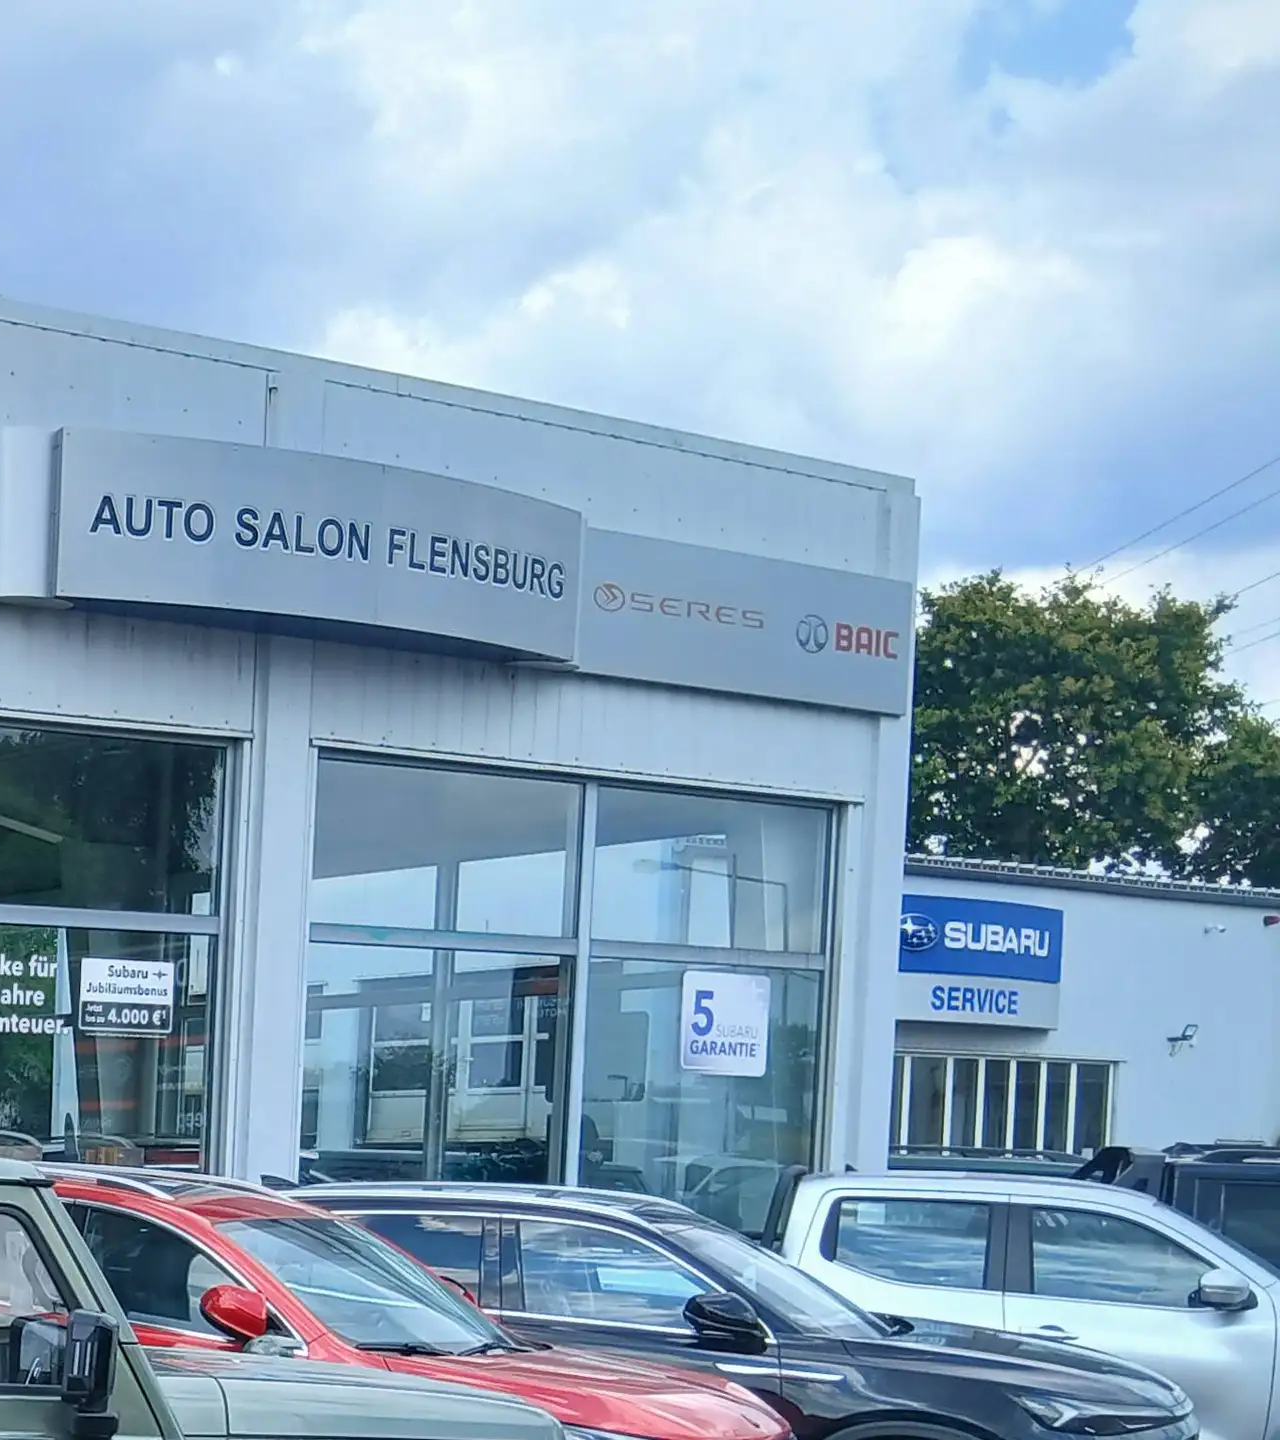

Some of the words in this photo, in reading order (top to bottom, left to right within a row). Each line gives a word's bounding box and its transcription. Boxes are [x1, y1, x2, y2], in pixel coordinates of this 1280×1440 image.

[90, 495, 214, 542] AUTO
[235, 508, 370, 560] SALON
[388, 528, 564, 599] FLENSBURG
[630, 592, 764, 629] SERES
[835, 622, 899, 659] BAIC
[944, 921, 1049, 957] SUBARU
[28, 954, 57, 977] für
[107, 965, 148, 979] Subaru
[86, 982, 168, 997] Jubiläumsbonus
[931, 985, 1019, 1015] SERVICE
[108, 1008, 148, 1025] 4.000
[691, 990, 714, 1036] 5
[716, 1024, 758, 1038] SUBARU
